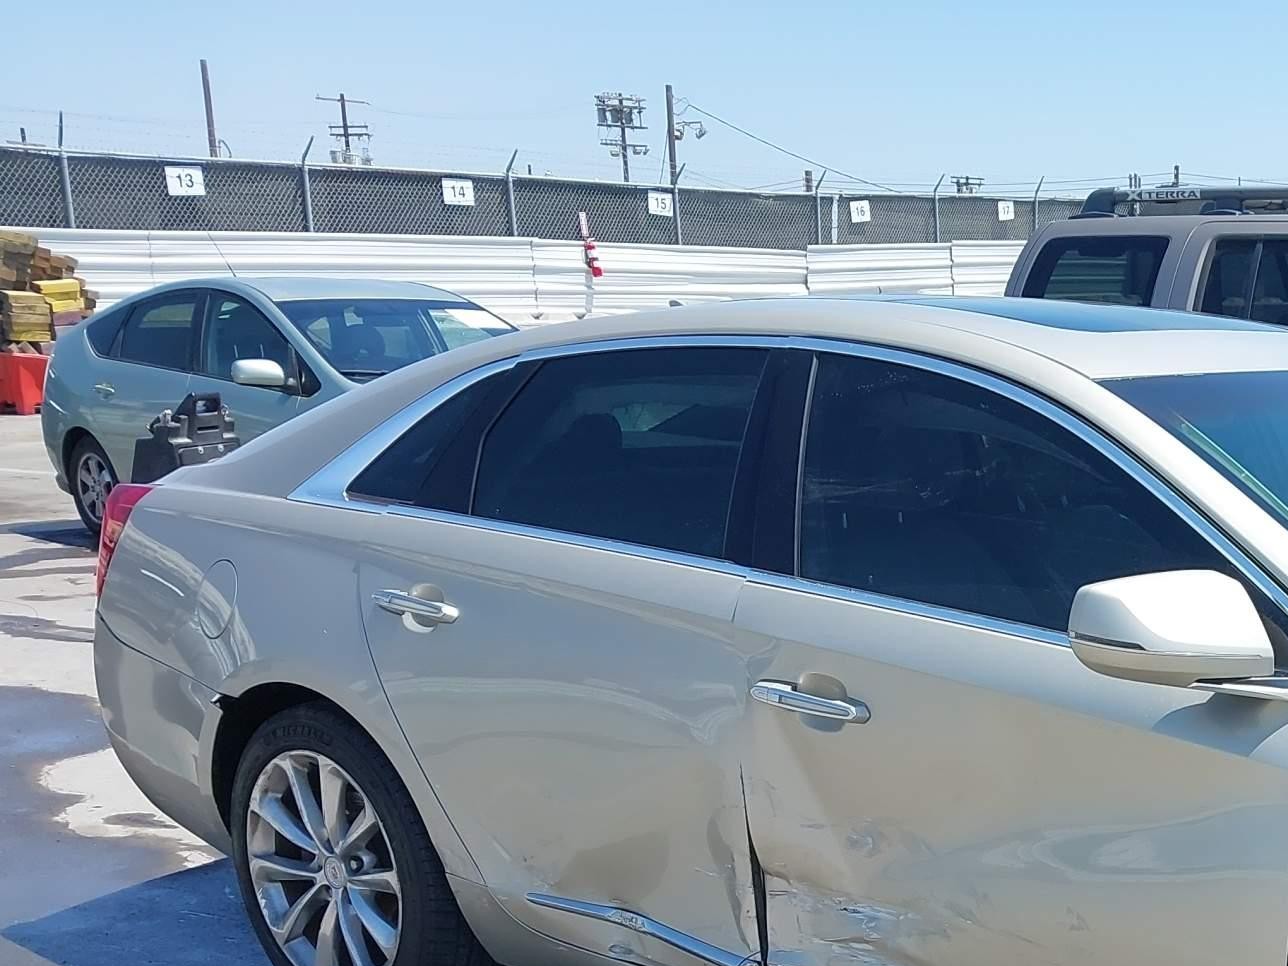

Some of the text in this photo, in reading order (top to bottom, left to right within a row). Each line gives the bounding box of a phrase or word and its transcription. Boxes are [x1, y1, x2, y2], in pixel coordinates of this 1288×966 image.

[175, 173, 194, 188] 13
[451, 185, 466, 198] 14
[655, 197, 667, 210] 15
[856, 205, 866, 217] 16
